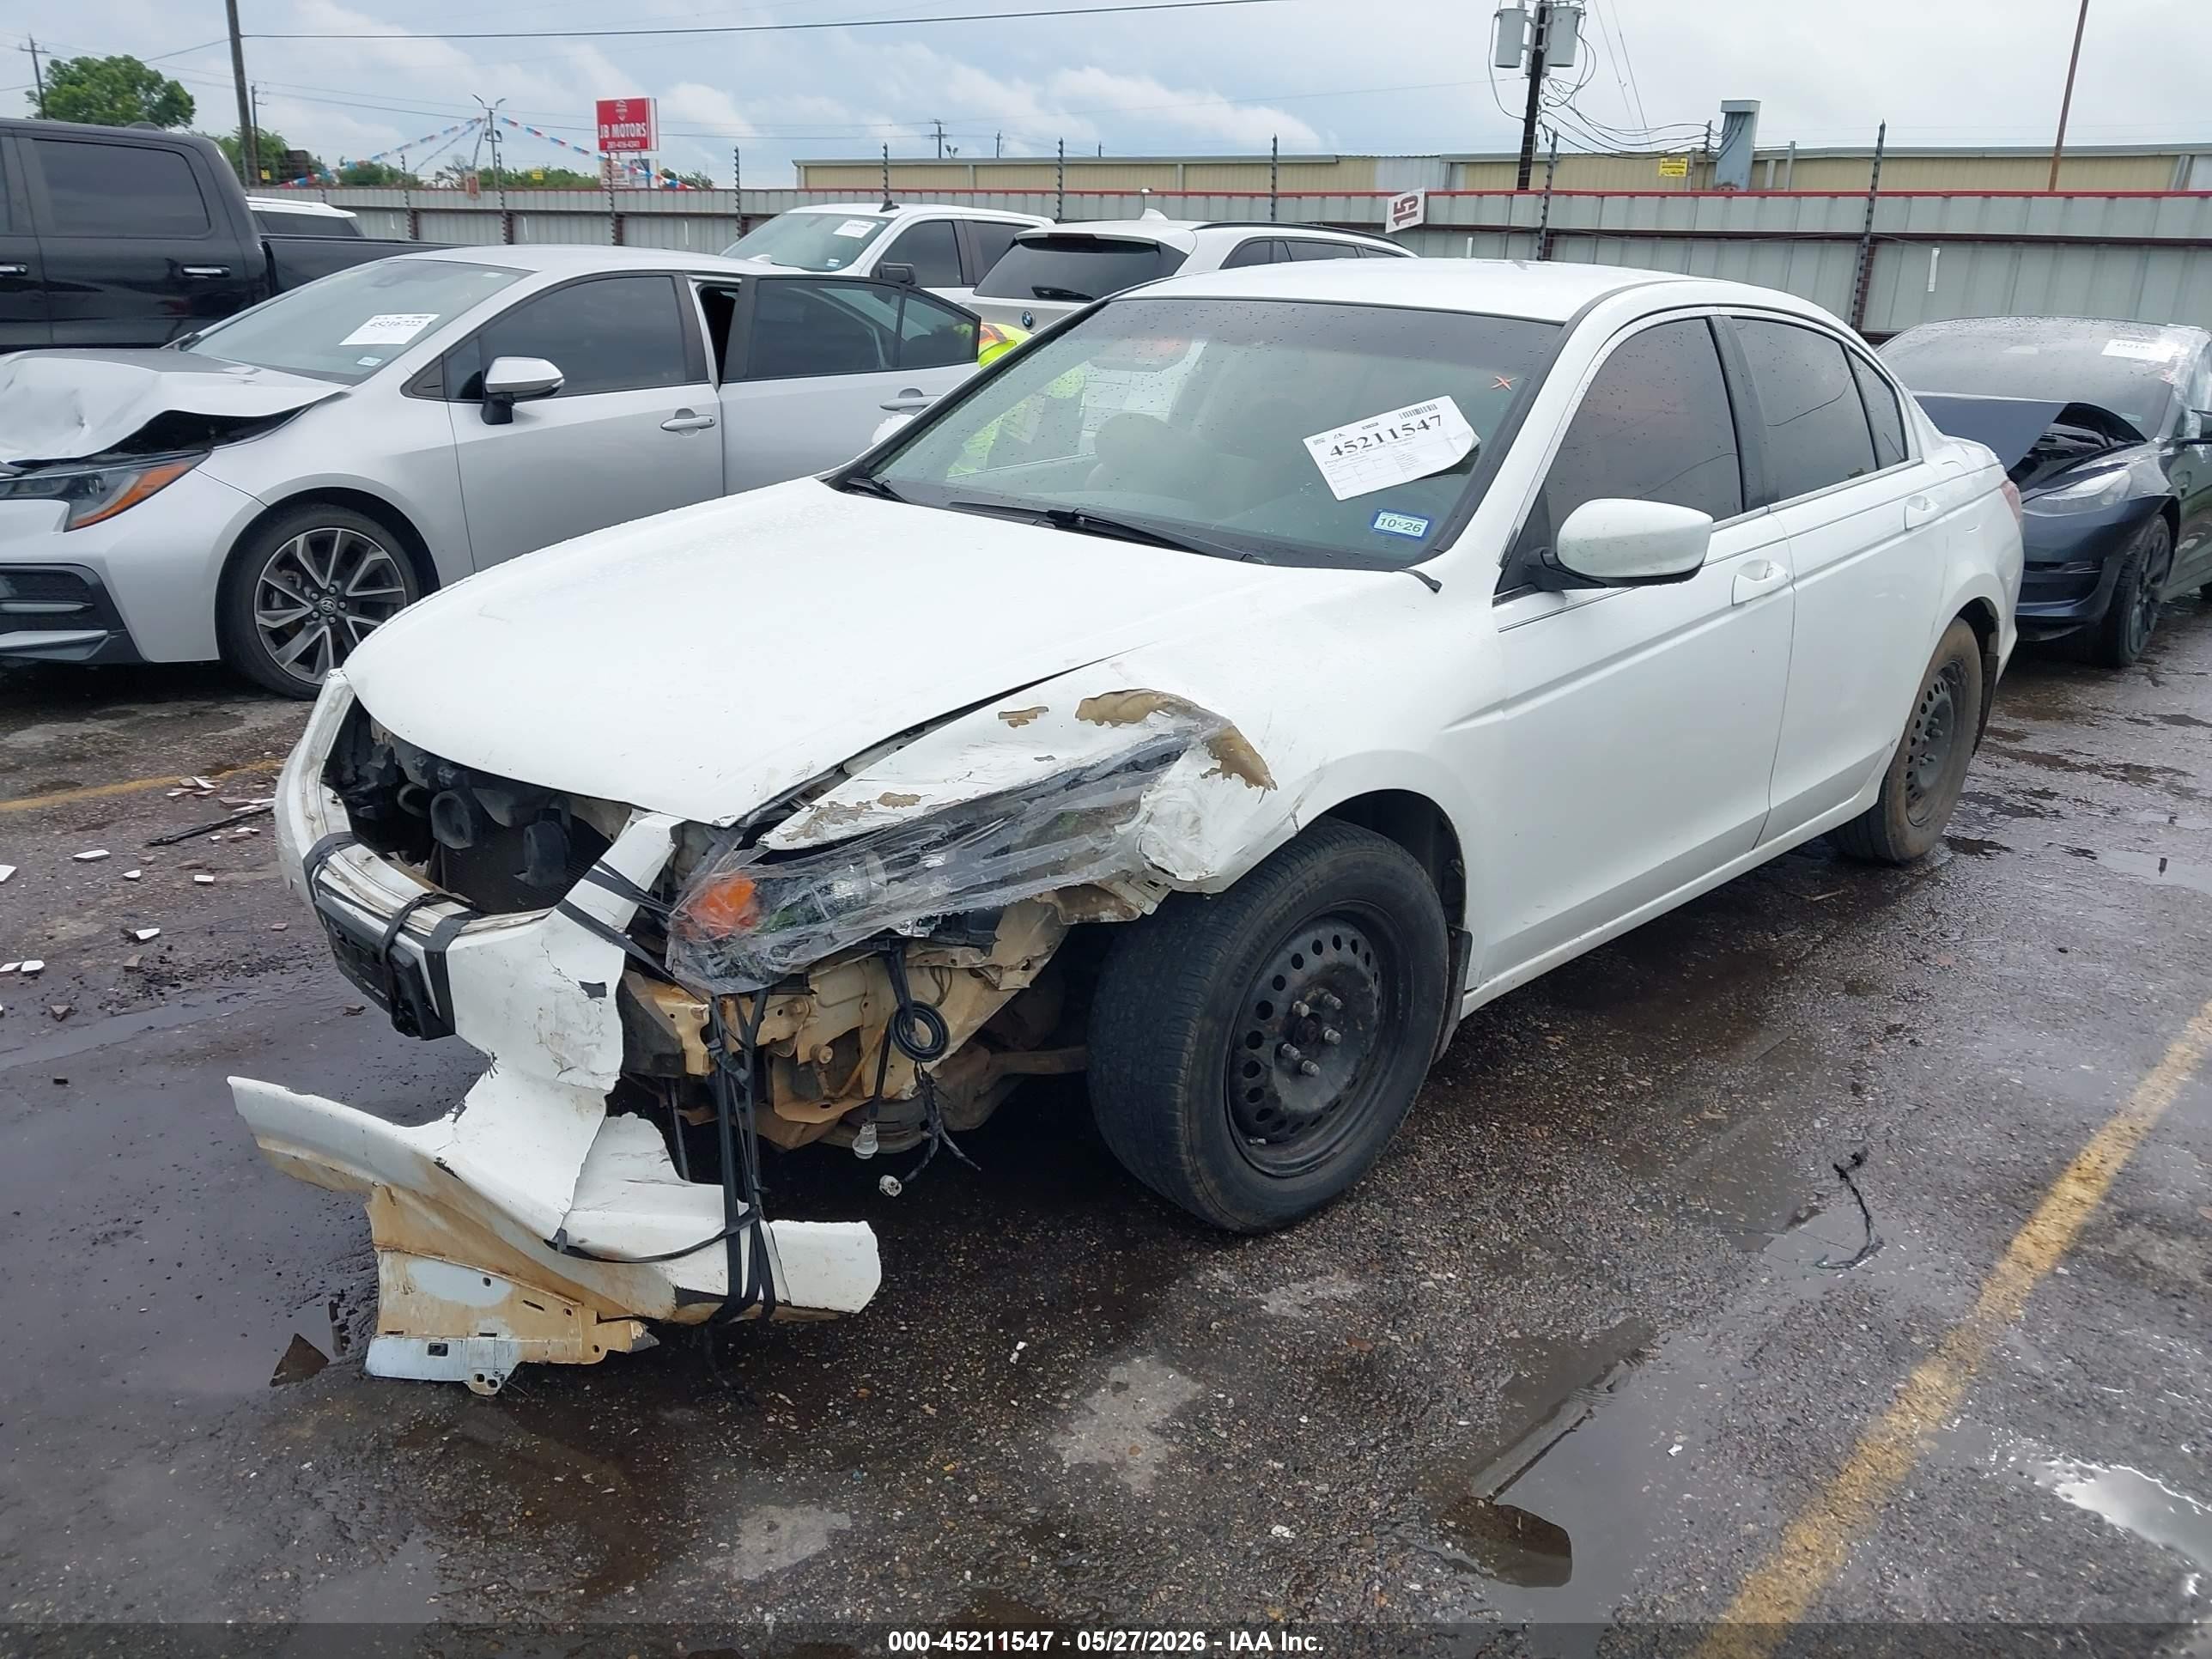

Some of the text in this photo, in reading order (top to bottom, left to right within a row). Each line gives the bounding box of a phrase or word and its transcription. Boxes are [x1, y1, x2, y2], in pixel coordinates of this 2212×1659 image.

[599, 123, 647, 138] JB MOTORS
[1393, 195, 1419, 227] 15
[1330, 414, 1442, 457] 45211547
